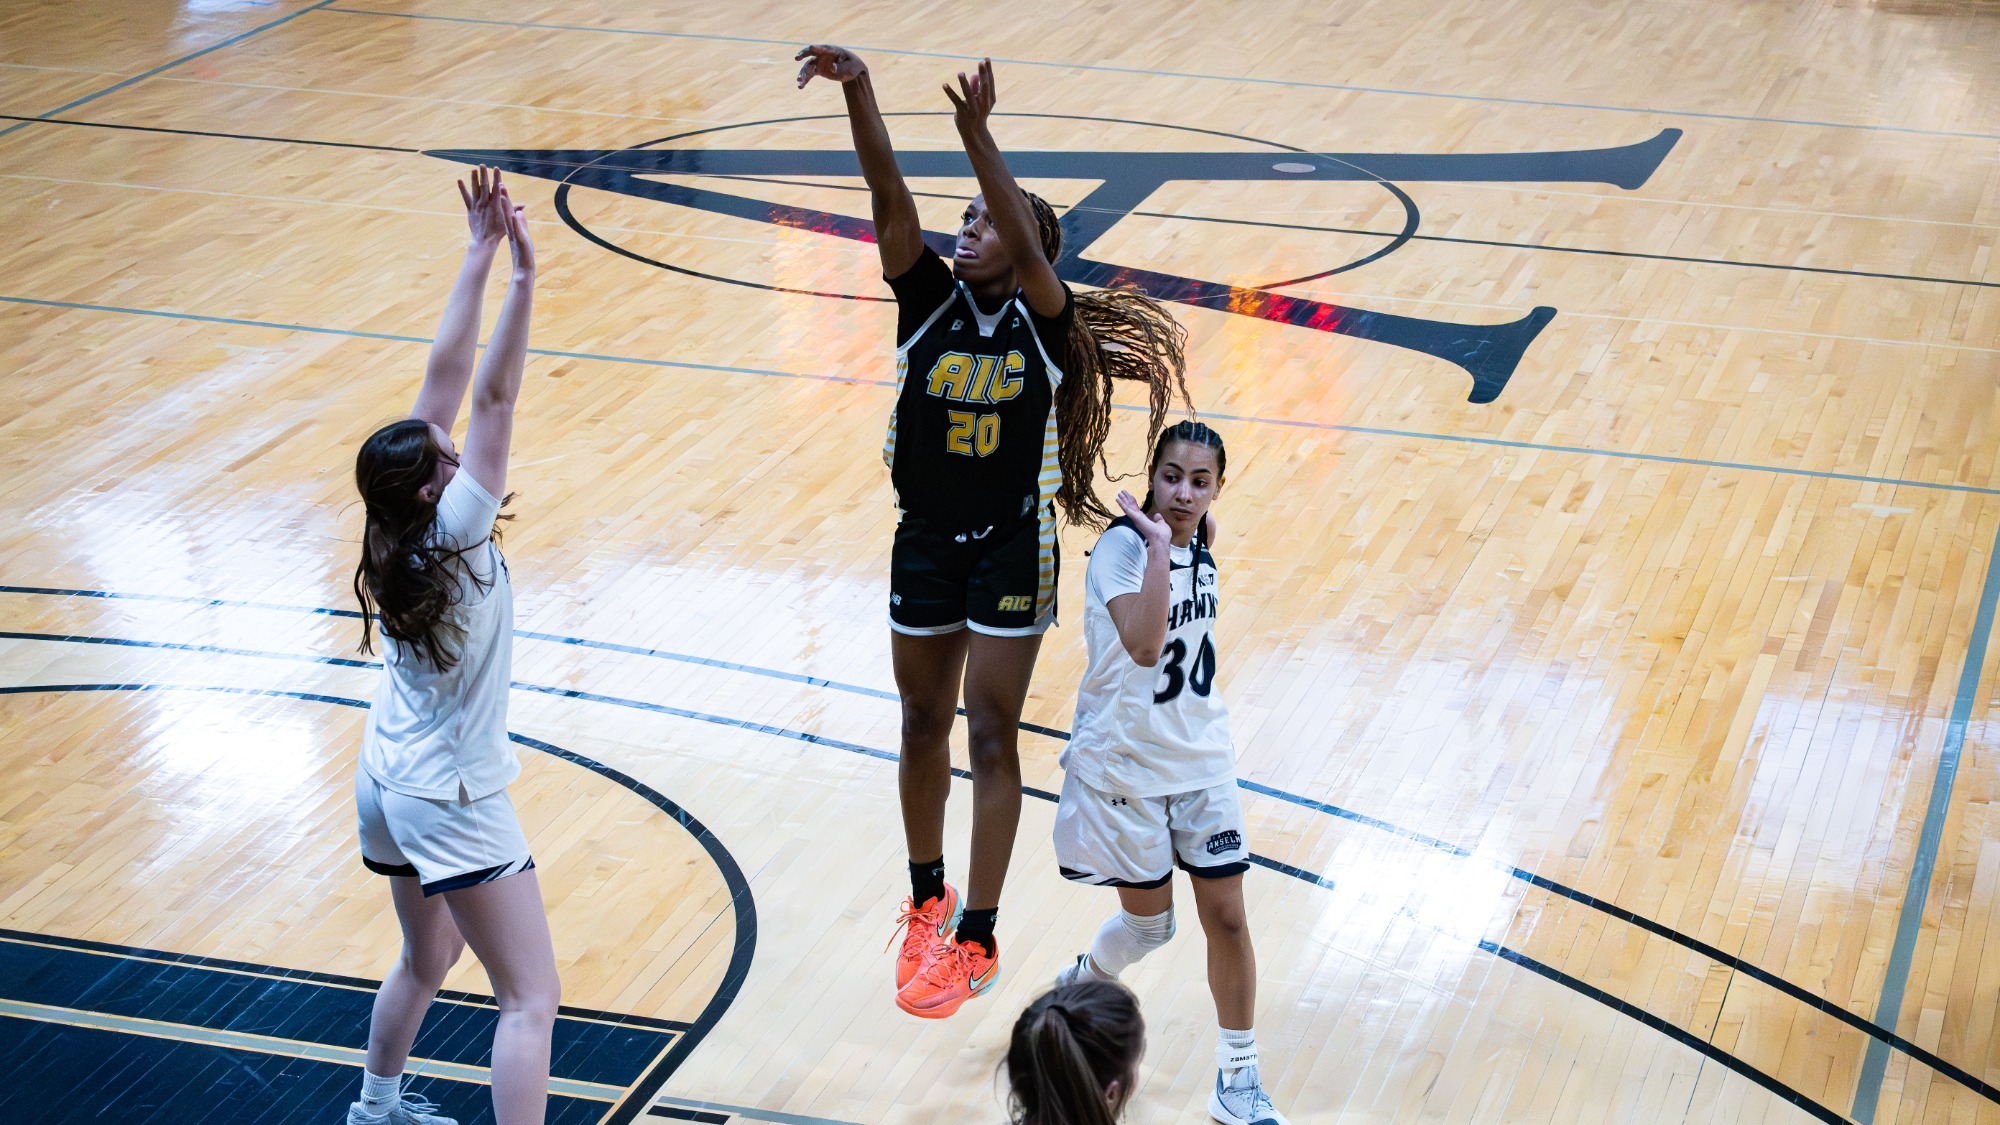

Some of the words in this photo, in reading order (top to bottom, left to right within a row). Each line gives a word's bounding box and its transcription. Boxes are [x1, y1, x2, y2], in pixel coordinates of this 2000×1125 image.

[926, 350, 1025, 404] AIC
[947, 410, 1001, 458] 20
[998, 595, 1033, 611] AIC
[1153, 631, 1217, 706] 30
[1208, 835, 1241, 851] ANSELM
